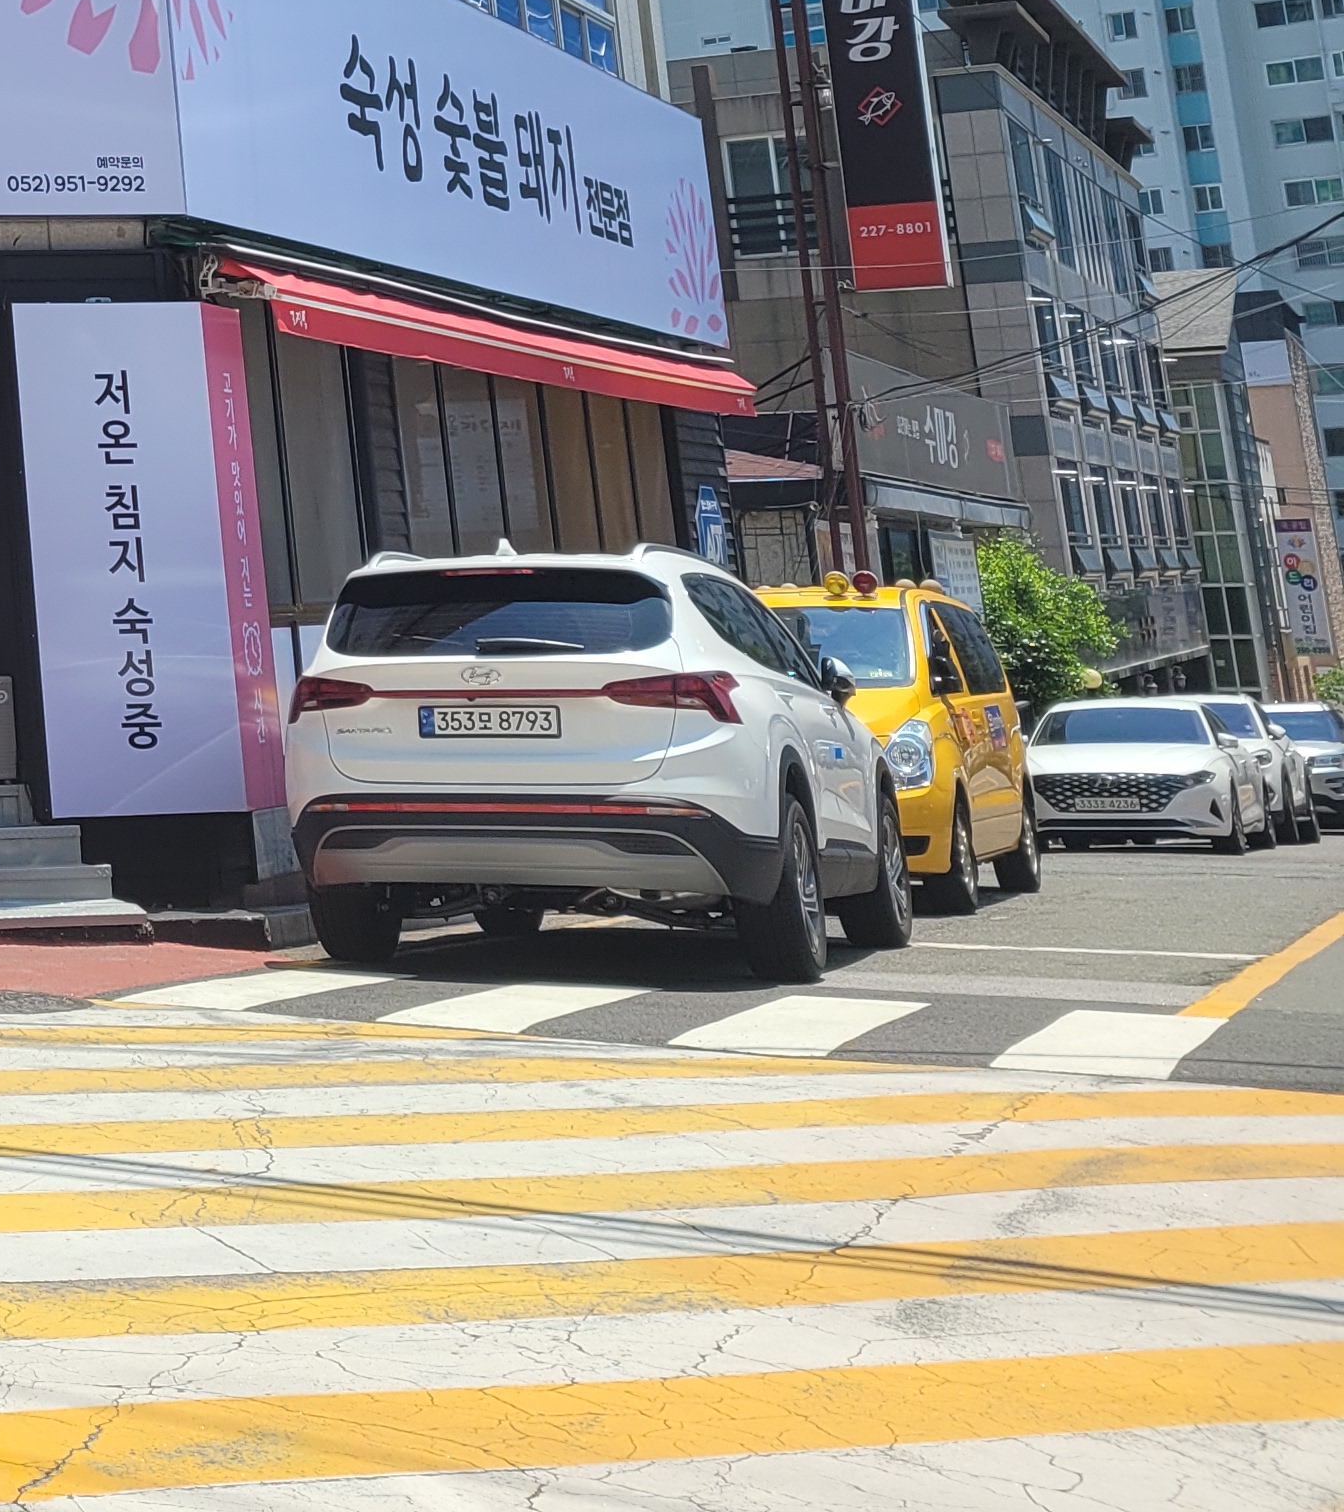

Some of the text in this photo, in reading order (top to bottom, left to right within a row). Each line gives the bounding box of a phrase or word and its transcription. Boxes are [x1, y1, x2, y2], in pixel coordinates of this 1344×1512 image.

[339, 33, 635, 249] 숙성 숯불 돼지 전문점
[96, 156, 145, 170] 예약문의
[858, 219, 933, 239] 227-8801
[923, 405, 959, 470] 수미강
[222, 372, 238, 451] 고기가
[231, 460, 247, 547] 맛있어
[1297, 593, 1318, 636] 어린이집
[436, 710, 554, 733] 353모 8793
